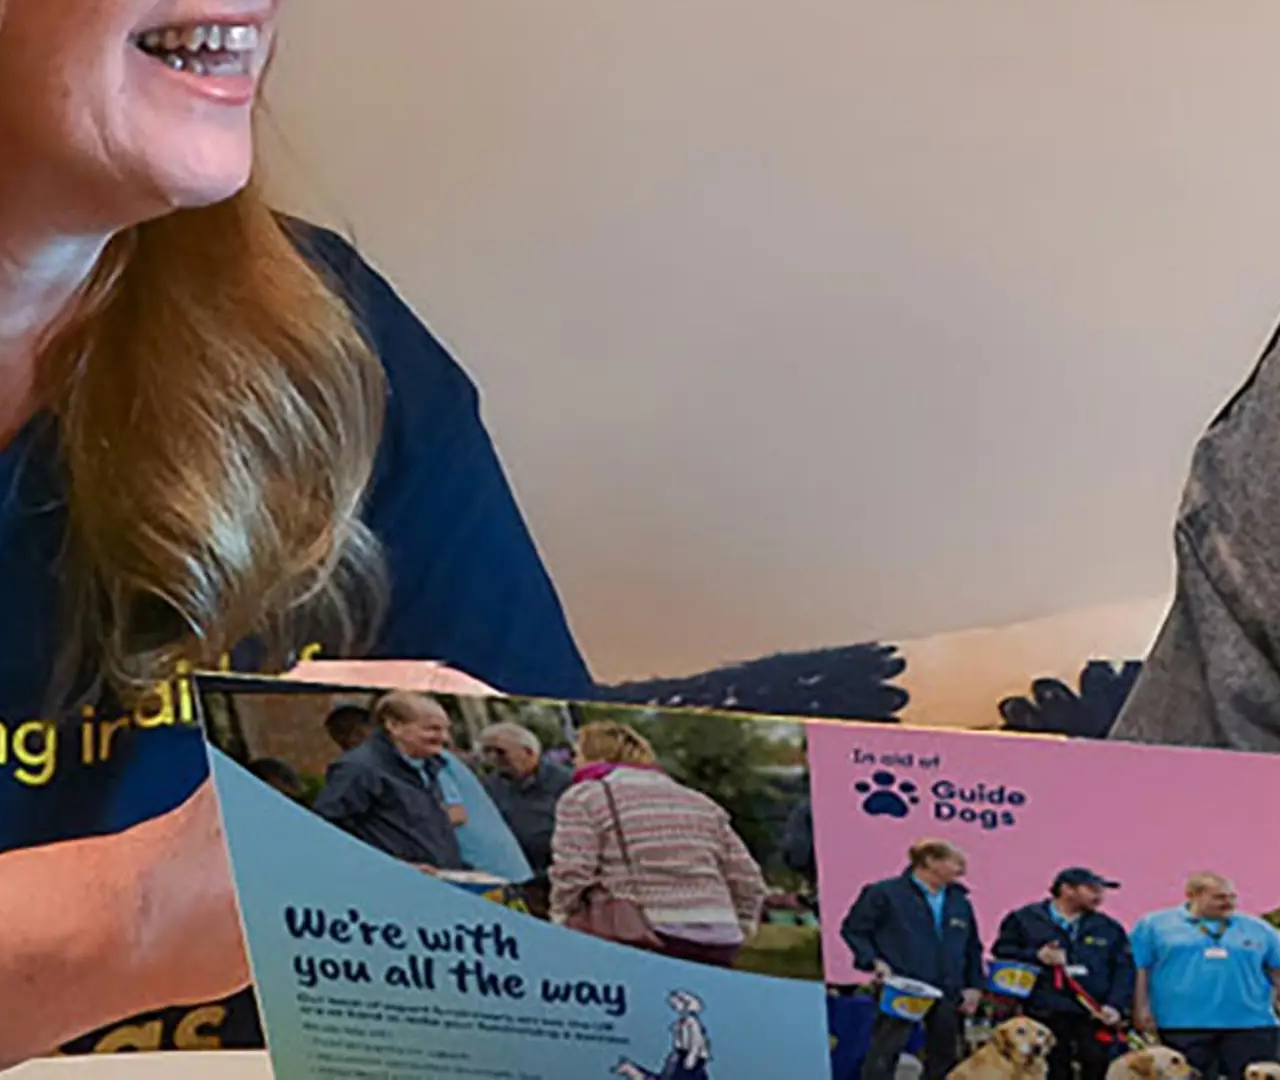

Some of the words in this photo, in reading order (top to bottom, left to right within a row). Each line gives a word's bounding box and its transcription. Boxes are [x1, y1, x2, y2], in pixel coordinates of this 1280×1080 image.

[853, 748, 877, 764] In
[931, 780, 1026, 806] Guide
[934, 801, 1016, 830] Dogs
[285, 906, 407, 951] We're
[417, 923, 519, 961] with
[294, 954, 372, 988] you
[385, 955, 435, 990] all
[447, 960, 527, 999] the
[540, 978, 627, 1016] way
